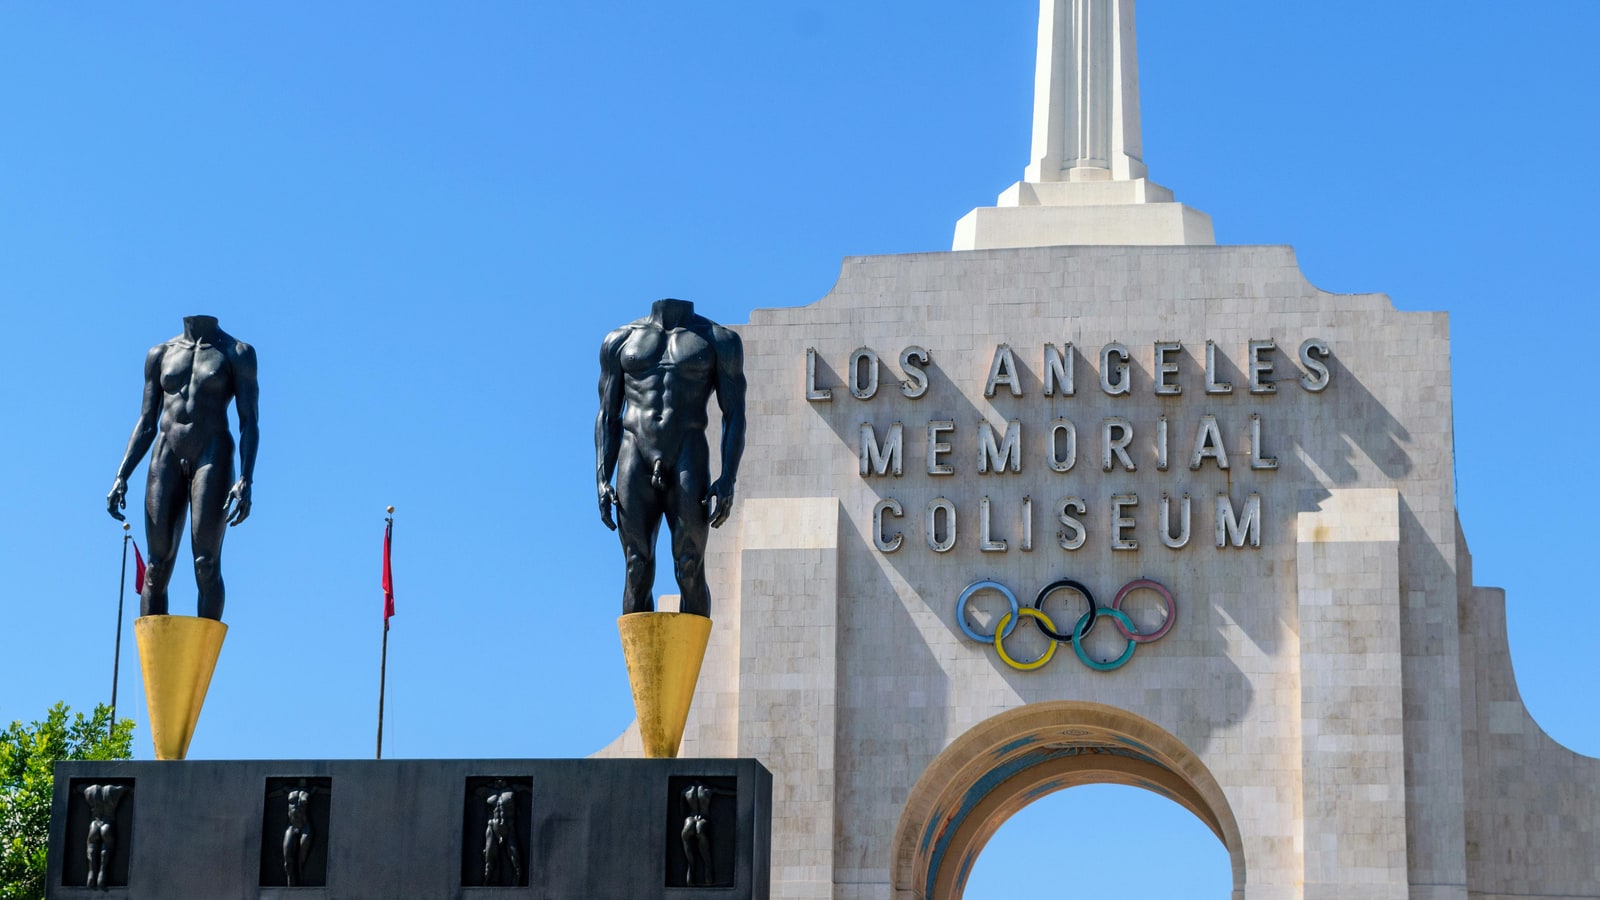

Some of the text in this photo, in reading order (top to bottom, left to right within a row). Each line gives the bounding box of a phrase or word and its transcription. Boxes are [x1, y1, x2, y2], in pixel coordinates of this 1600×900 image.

[806, 337, 1331, 402] LOS ANGELES
[858, 414, 1279, 478] MEMORIAL
[872, 492, 1262, 553] COLISEUM
